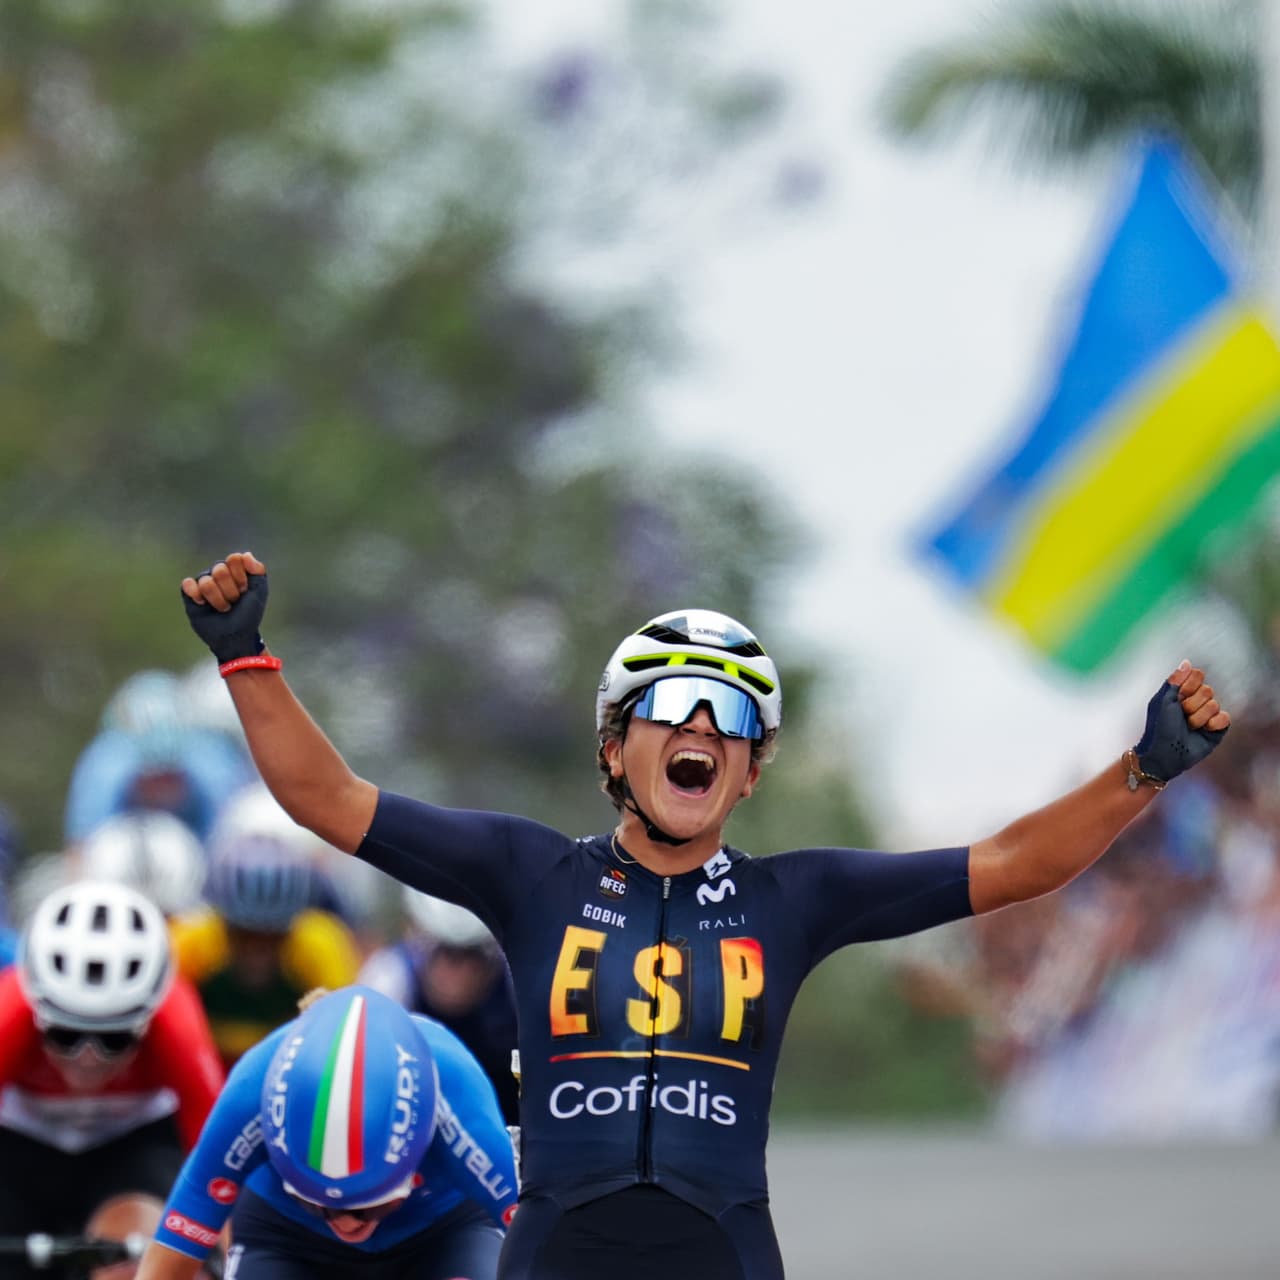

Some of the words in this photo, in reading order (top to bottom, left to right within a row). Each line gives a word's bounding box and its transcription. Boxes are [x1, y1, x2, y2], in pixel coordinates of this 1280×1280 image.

[600, 876, 626, 895] RFEC
[582, 903, 627, 929] GOBIK
[698, 914, 746, 931] RALI
[550, 924, 765, 1043] ESP
[384, 1043, 419, 1164] RUDY
[549, 1073, 738, 1126] Cofidis
